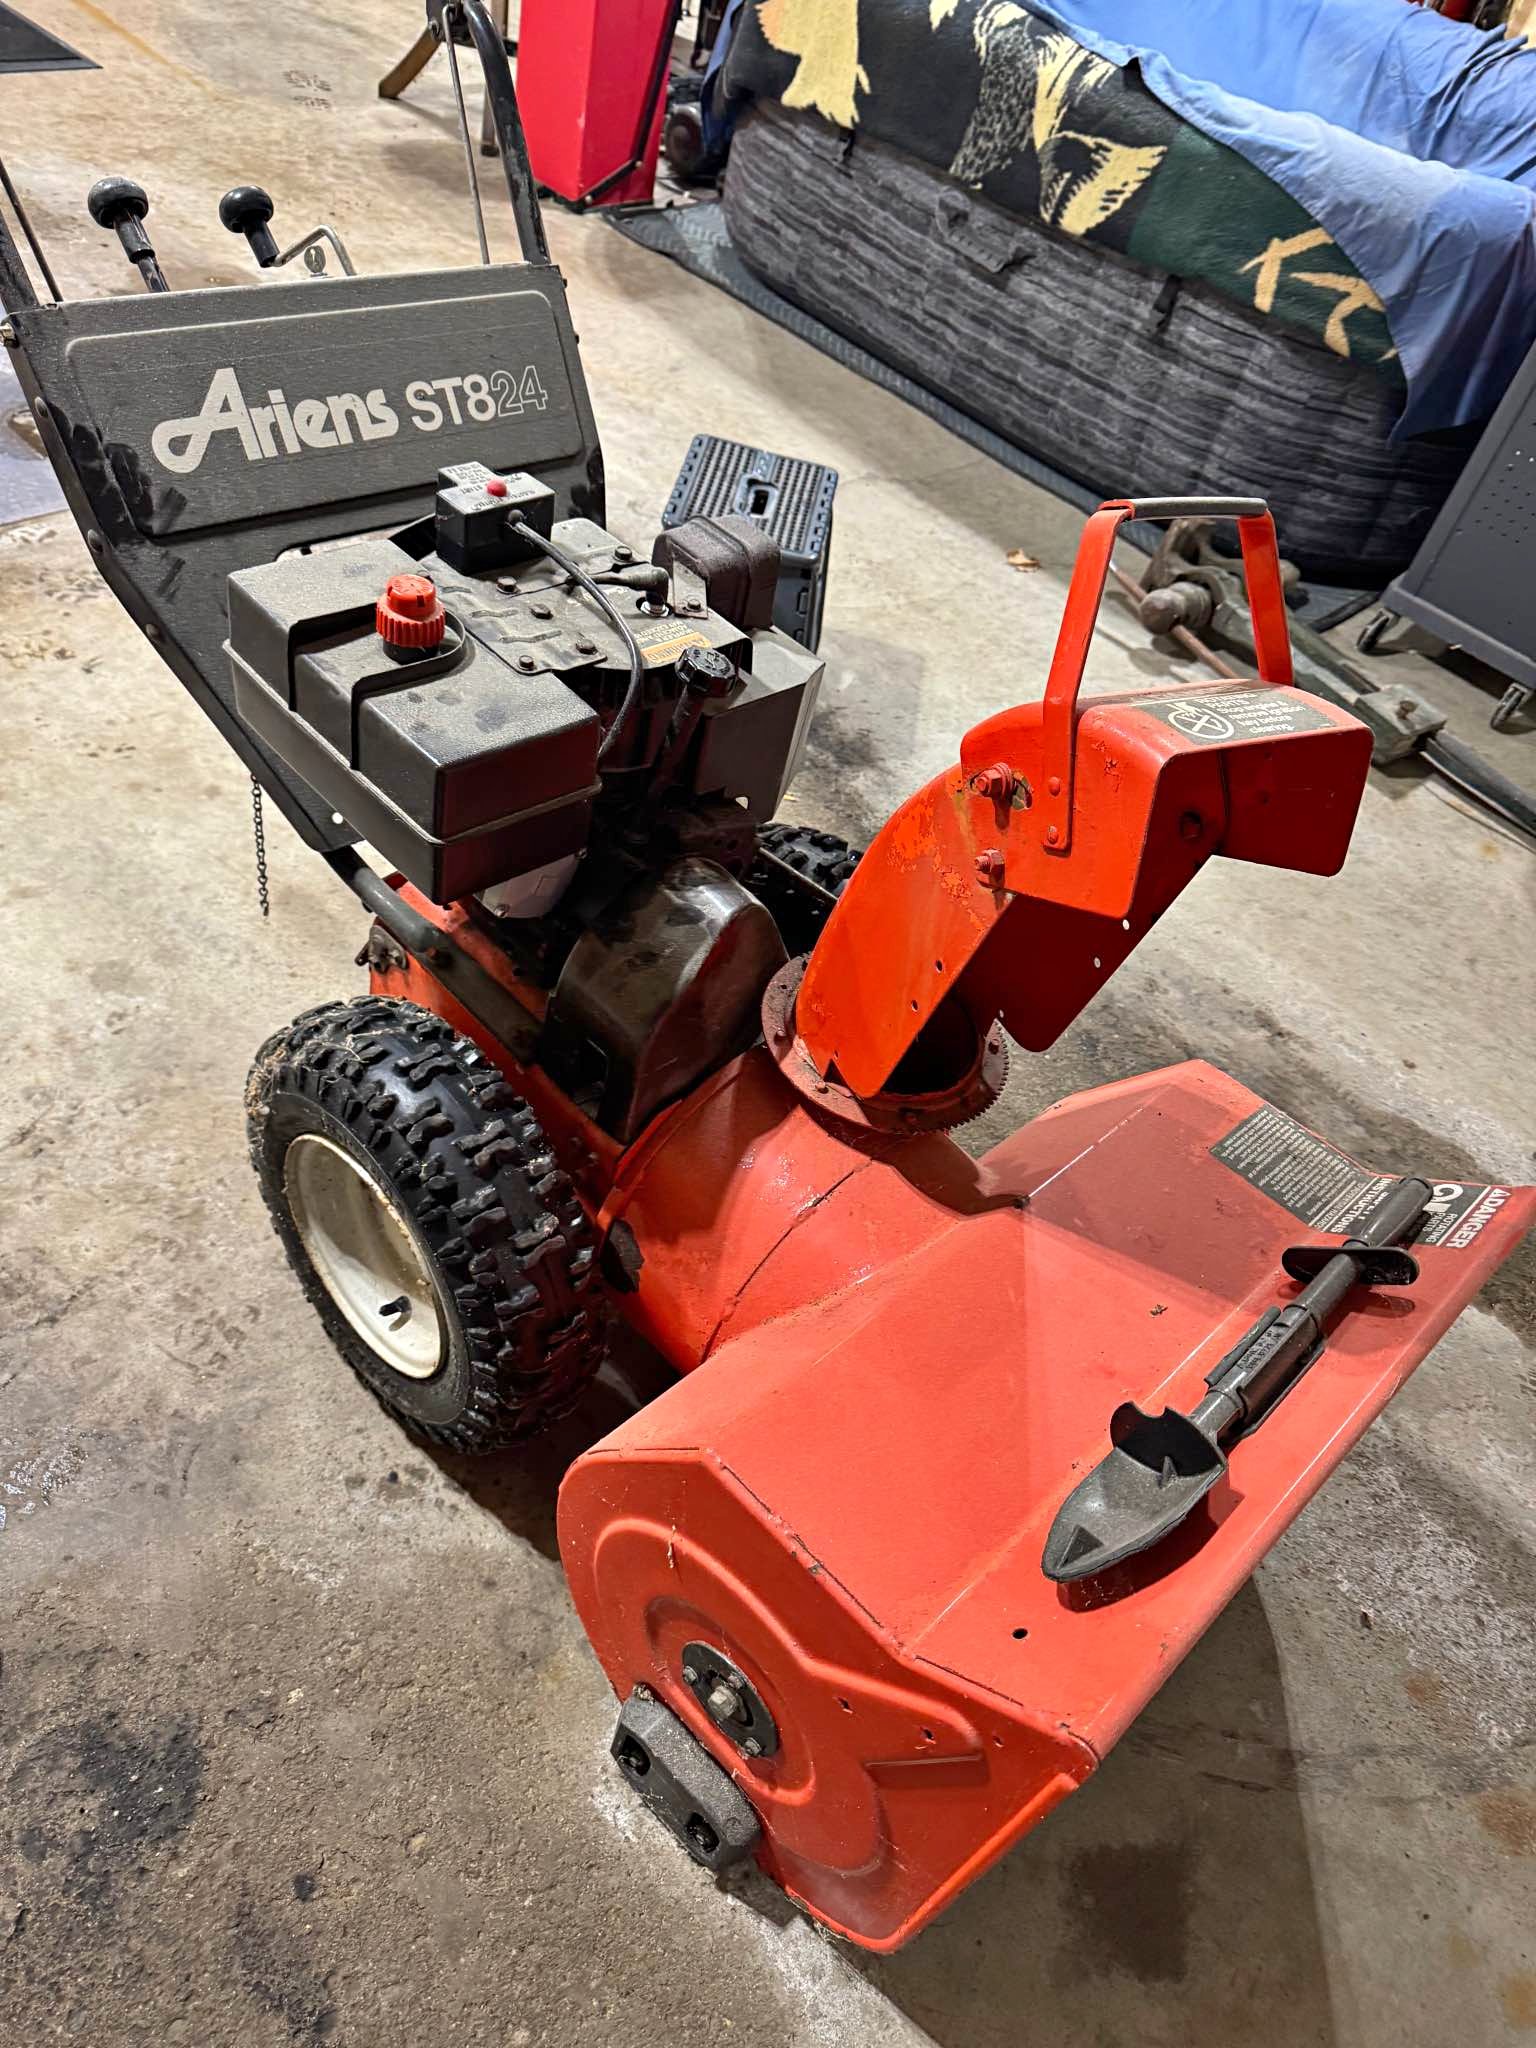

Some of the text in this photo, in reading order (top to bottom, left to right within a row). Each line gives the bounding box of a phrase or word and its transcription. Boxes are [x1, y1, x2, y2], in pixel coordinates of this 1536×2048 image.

[151, 365, 548, 475] Ariens ST824
[1330, 1178, 1393, 1233] INSTRUCTIONS
[1422, 1212, 1446, 1232] PARTS
[1425, 1213, 1458, 1243] ROTATING
[1446, 1198, 1505, 1248] DANGER
